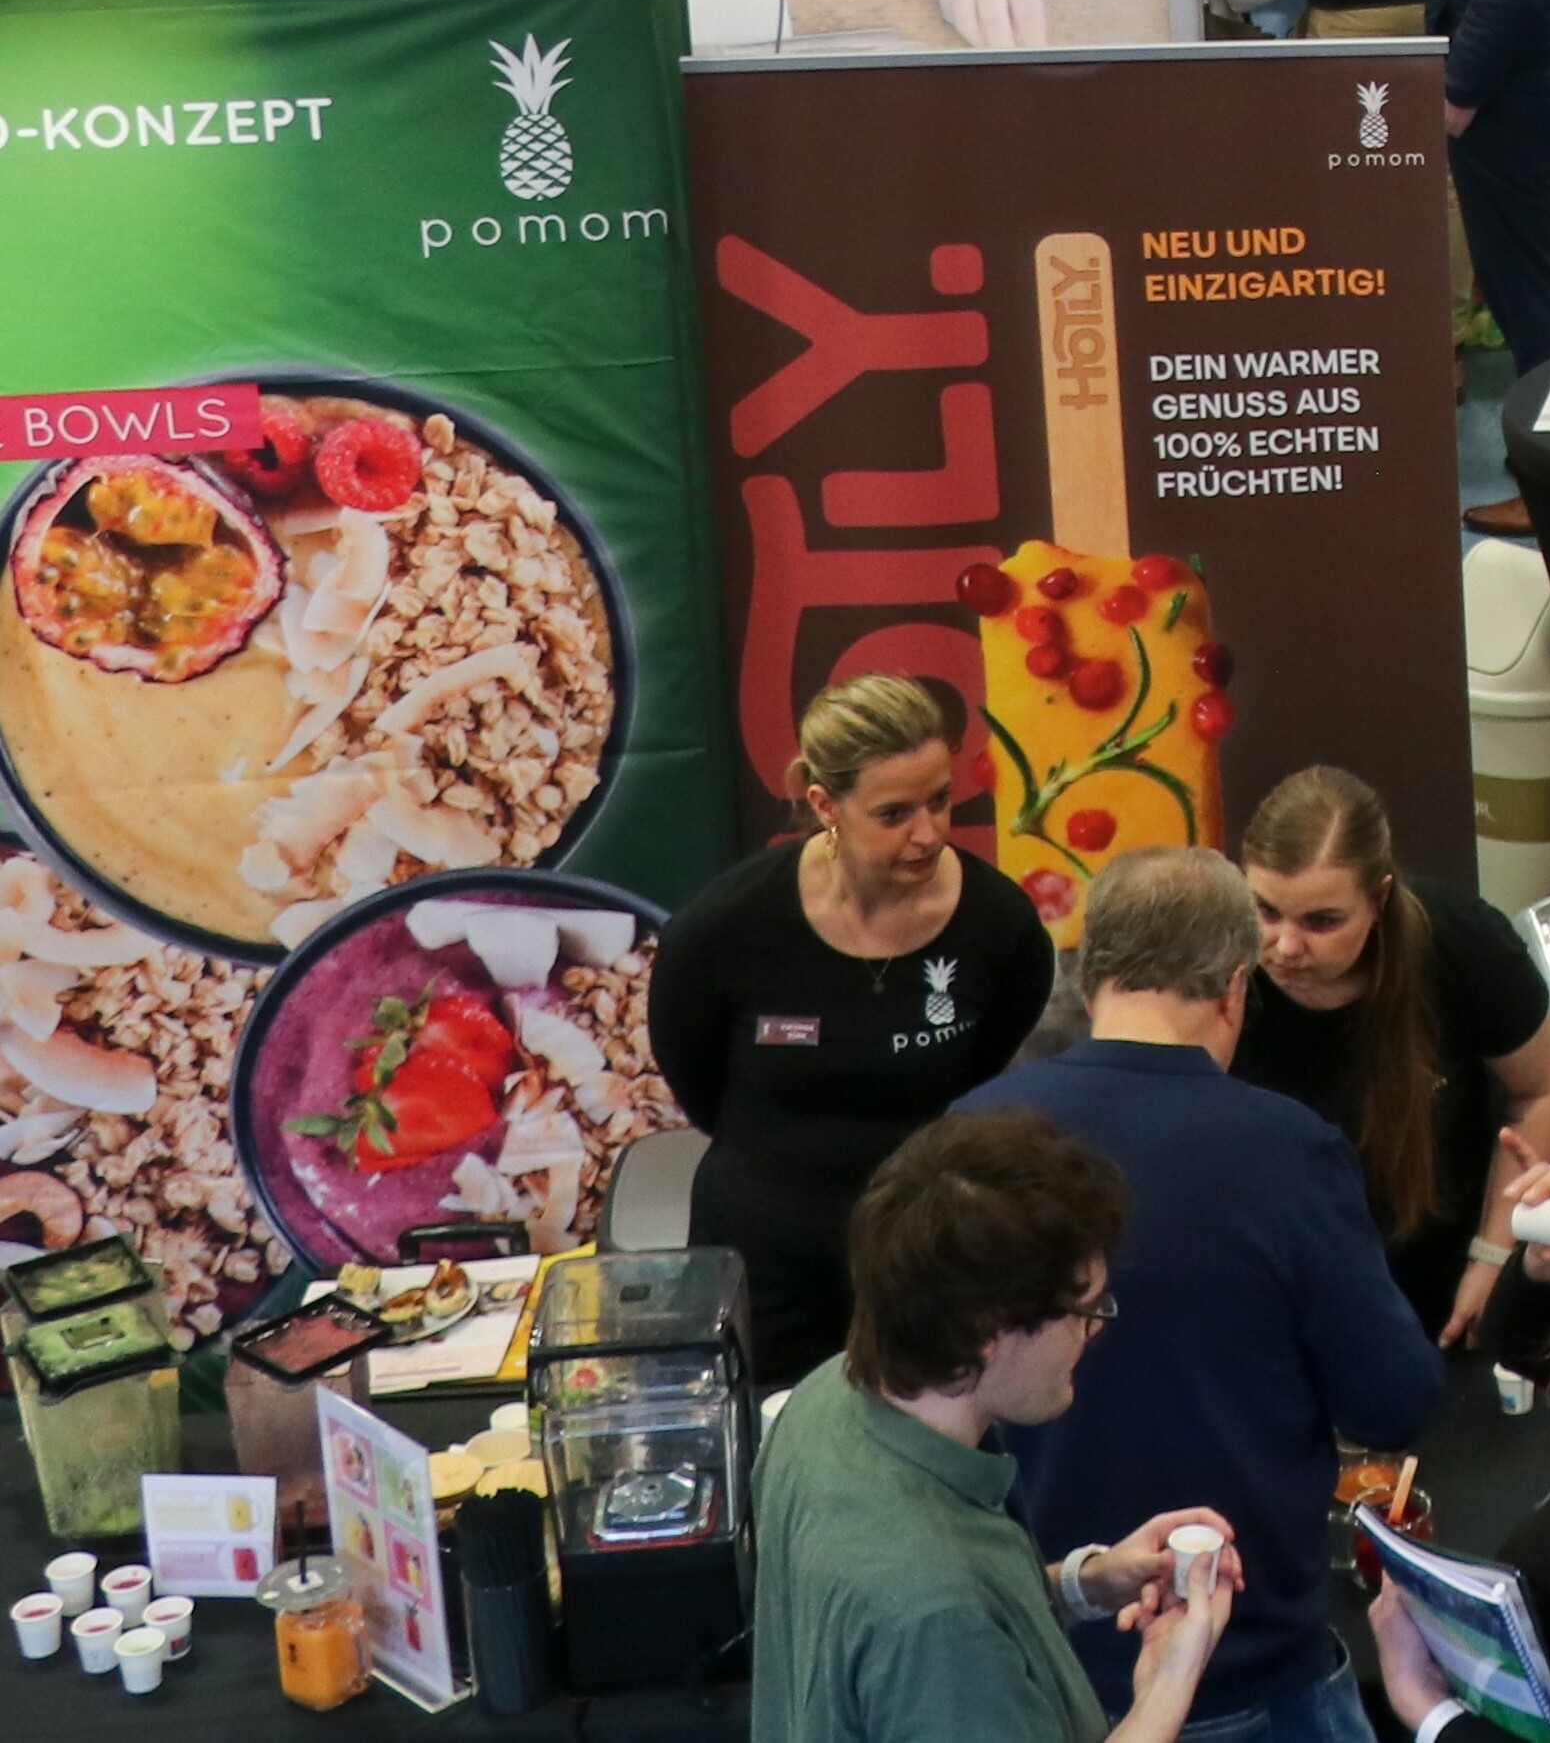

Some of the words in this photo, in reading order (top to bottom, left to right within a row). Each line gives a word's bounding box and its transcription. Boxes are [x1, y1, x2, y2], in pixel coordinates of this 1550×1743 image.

[1328, 148, 1426, 170] pomom
[419, 206, 669, 259] pomom
[1141, 228, 1219, 260] NEU
[1225, 226, 1307, 258] UND
[1144, 266, 1387, 303] EINZIGARTIG!
[1149, 352, 1229, 383] DEIN
[1233, 348, 1382, 380] WARMER
[1152, 389, 1289, 421] GENUSS
[1295, 386, 1362, 416] AUS
[23, 395, 233, 449] BOWLS
[1153, 429, 1243, 460] 100%
[1248, 425, 1380, 458] ECHTEN
[1156, 464, 1344, 499] FRÜCHTEN!
